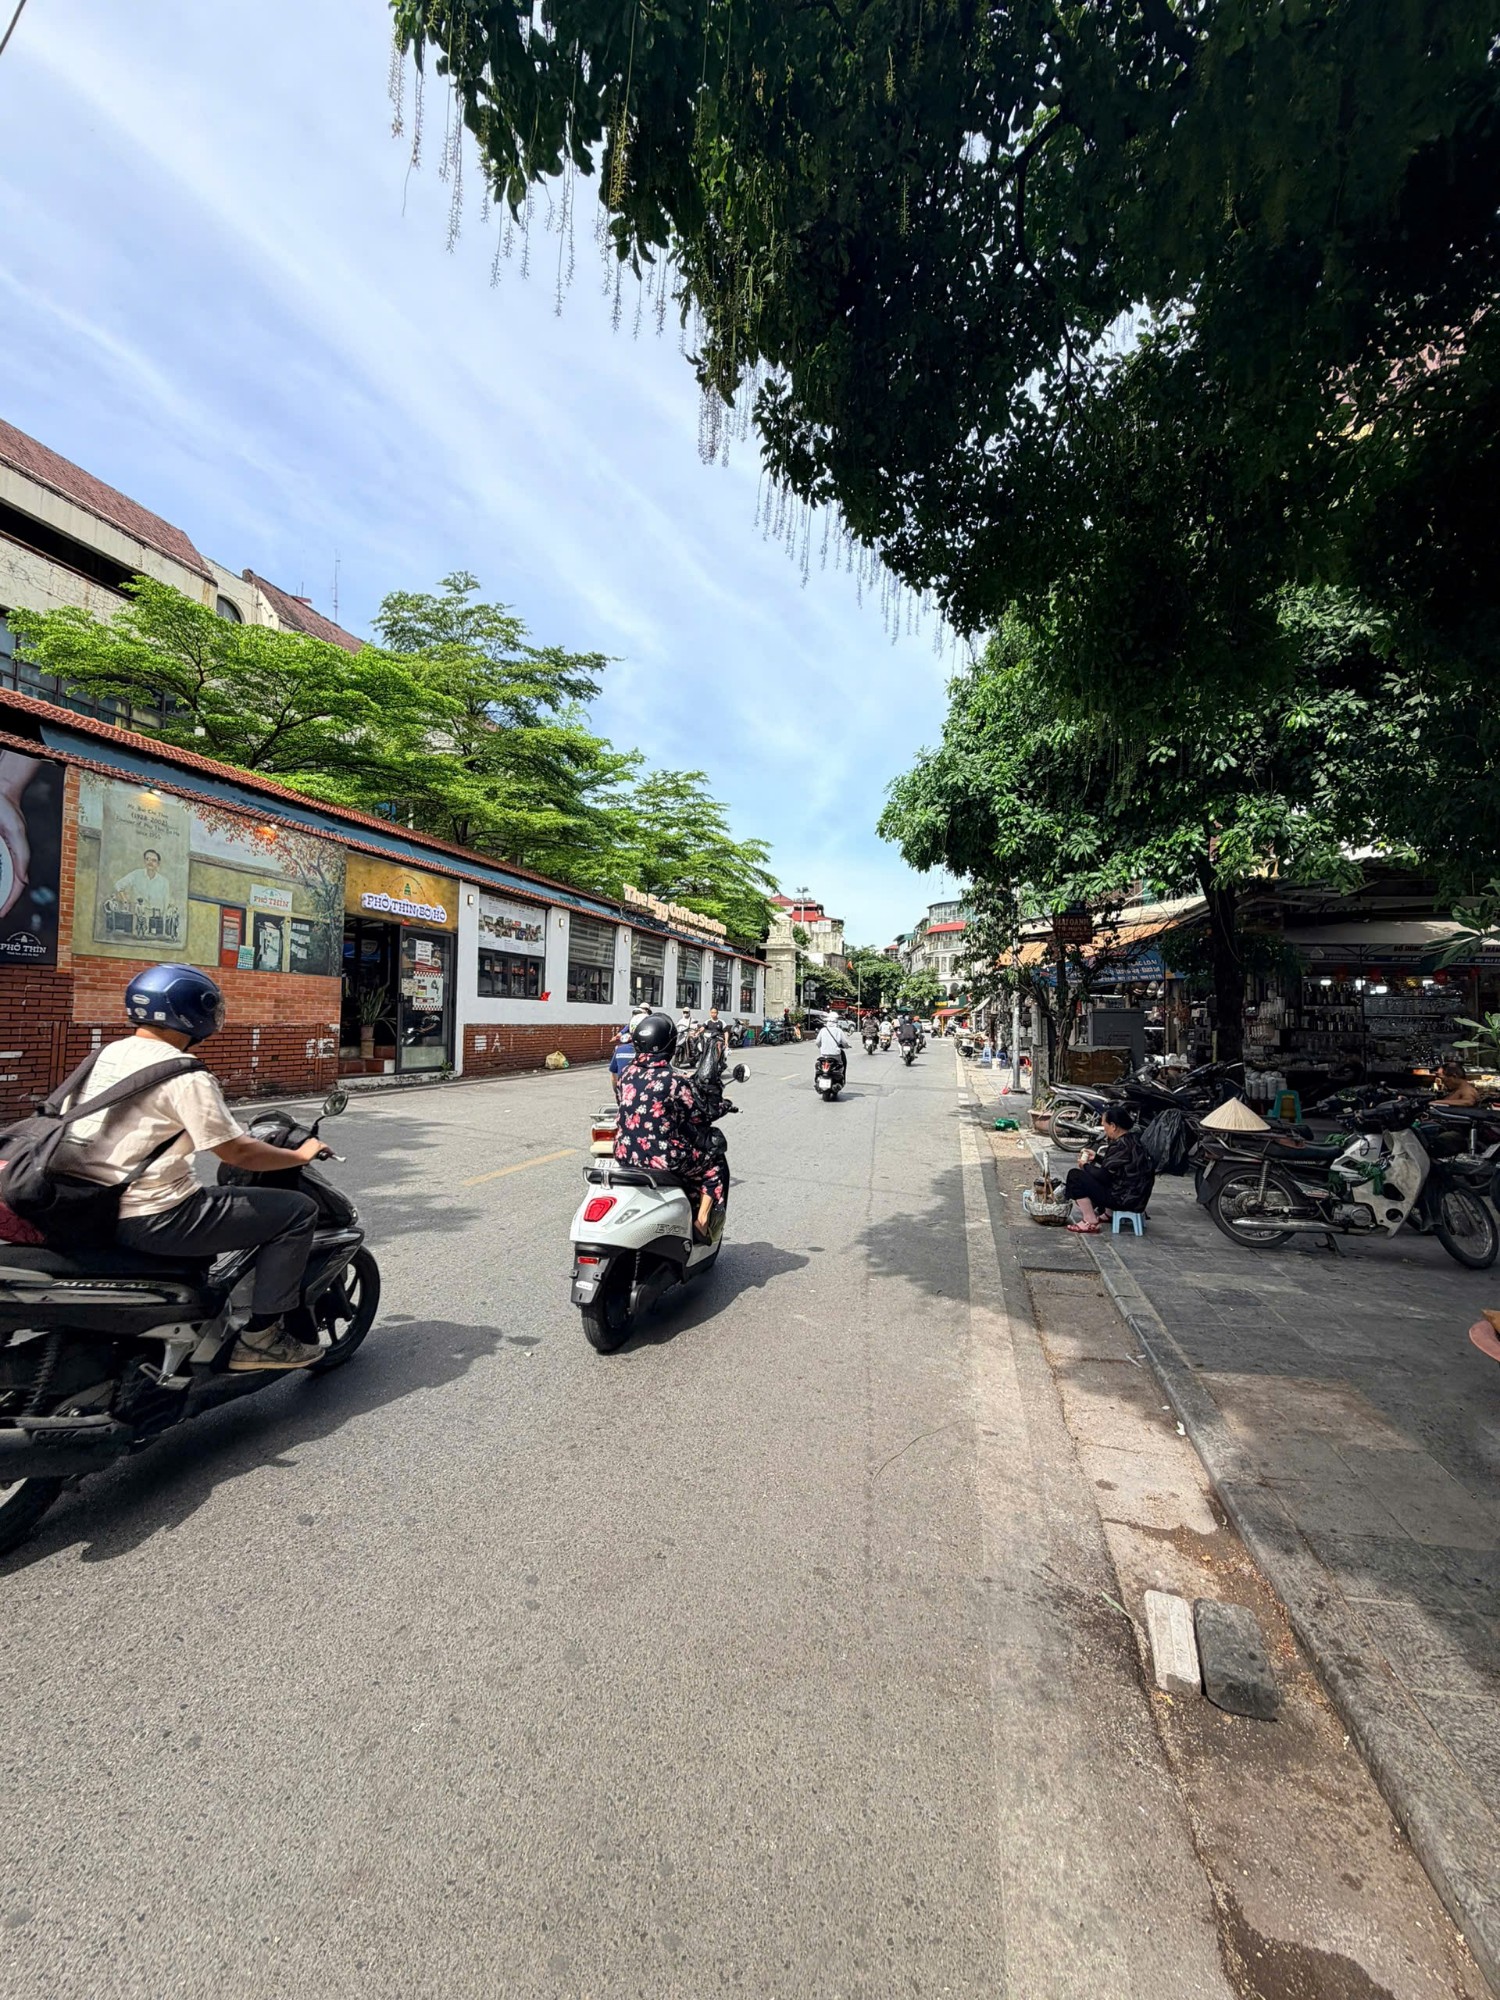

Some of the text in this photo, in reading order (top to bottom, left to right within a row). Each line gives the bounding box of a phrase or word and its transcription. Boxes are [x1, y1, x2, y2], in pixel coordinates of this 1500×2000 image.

[623, 883, 727, 935] The Egg Coffee Station
